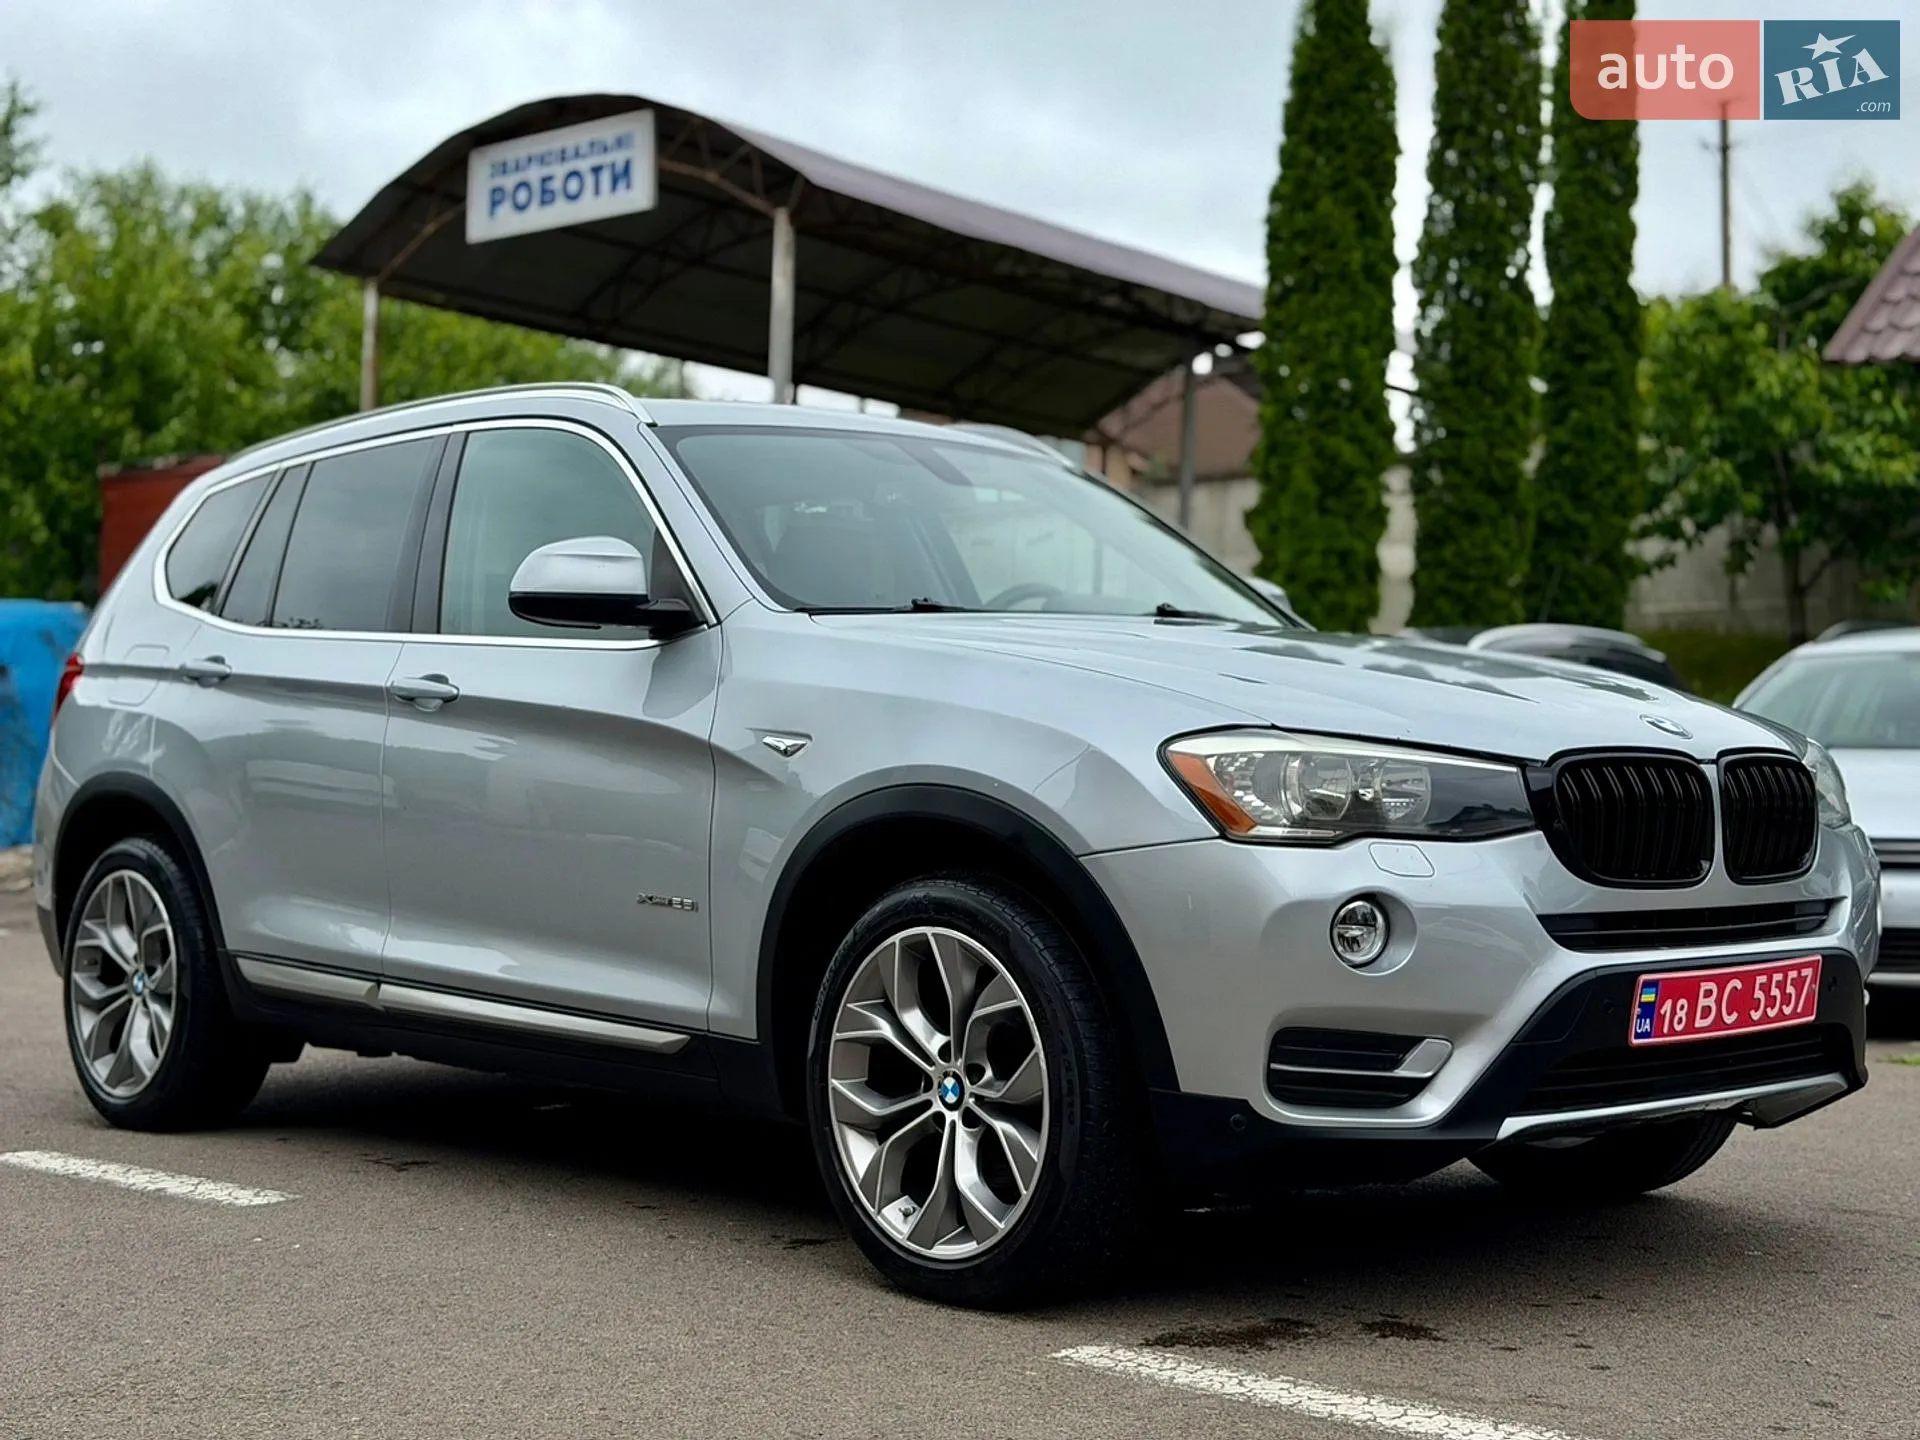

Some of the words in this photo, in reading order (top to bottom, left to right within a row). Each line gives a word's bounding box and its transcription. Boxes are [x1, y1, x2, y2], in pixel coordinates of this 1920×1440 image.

[488, 158, 633, 219] РОБОТИ
[1636, 1018, 1651, 1034] UA
[1660, 998, 1688, 1034] 18
[1694, 978, 1742, 1029] BC
[1750, 968, 1813, 1021] 5557
